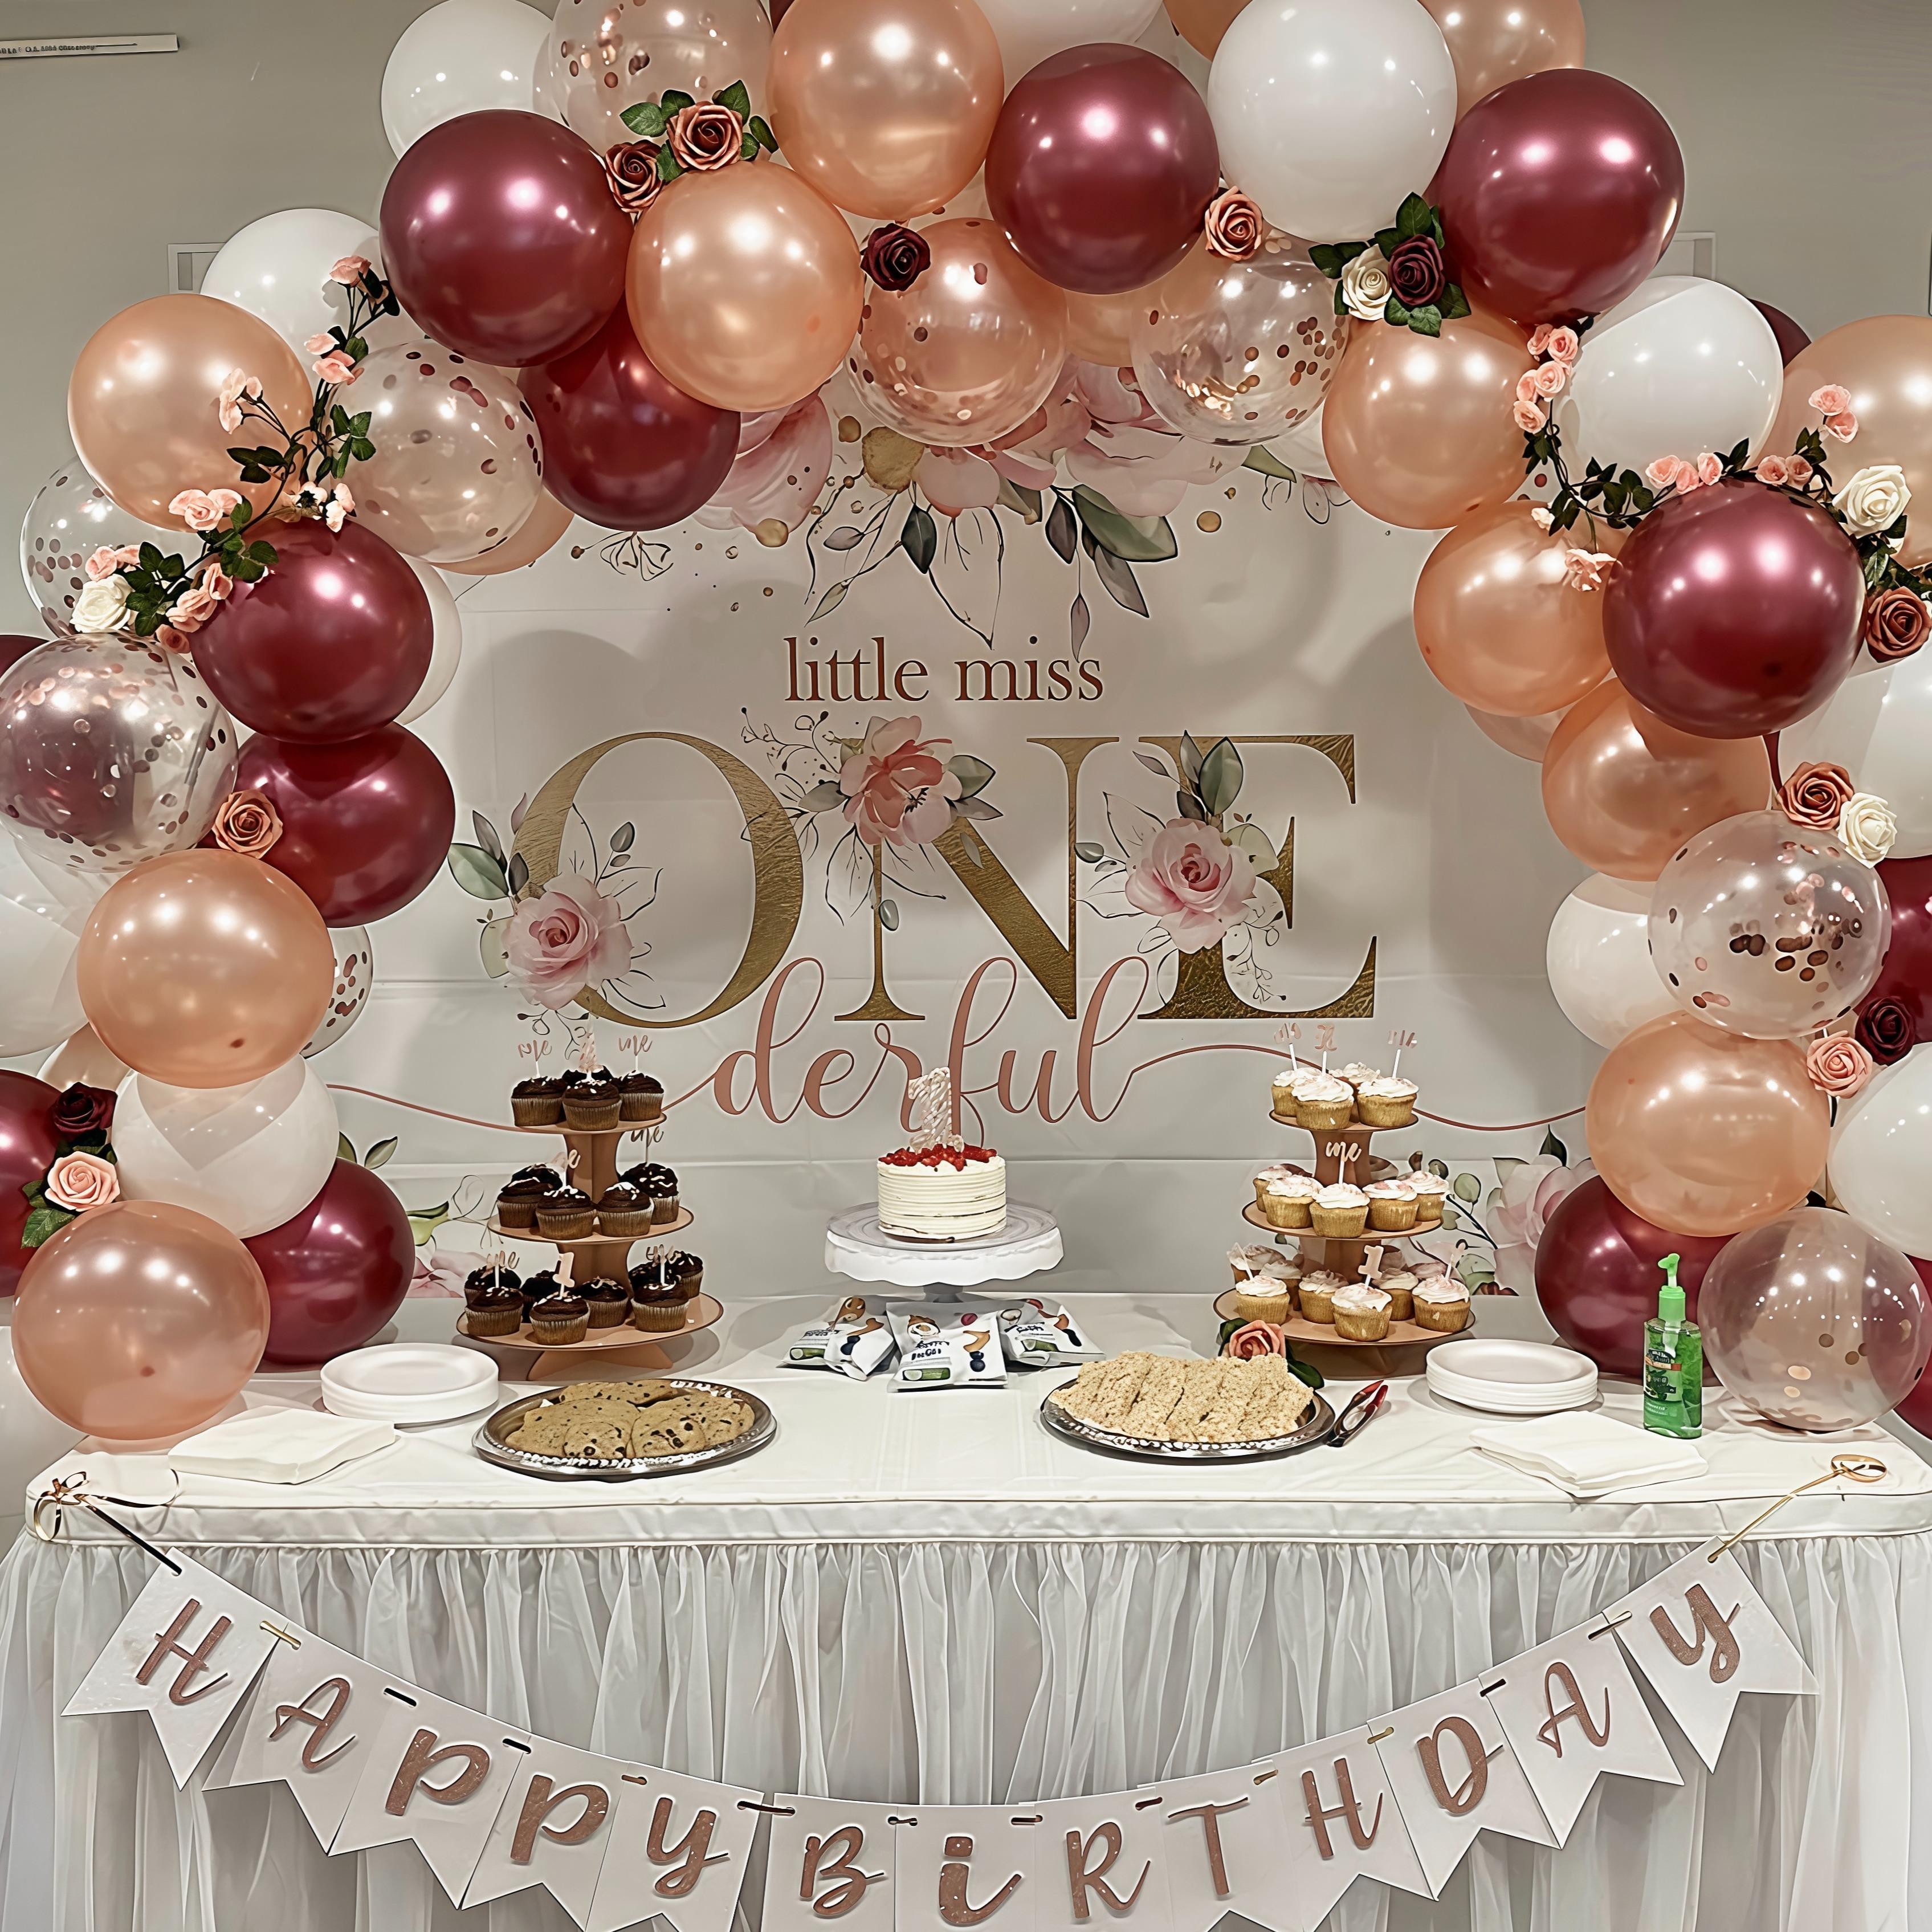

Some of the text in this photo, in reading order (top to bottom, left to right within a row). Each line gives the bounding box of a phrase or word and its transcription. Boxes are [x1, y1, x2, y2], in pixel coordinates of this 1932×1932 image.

[783, 635, 1104, 702] little miss
[508, 731, 1378, 1029] ONE
[712, 955, 1150, 1148] derful
